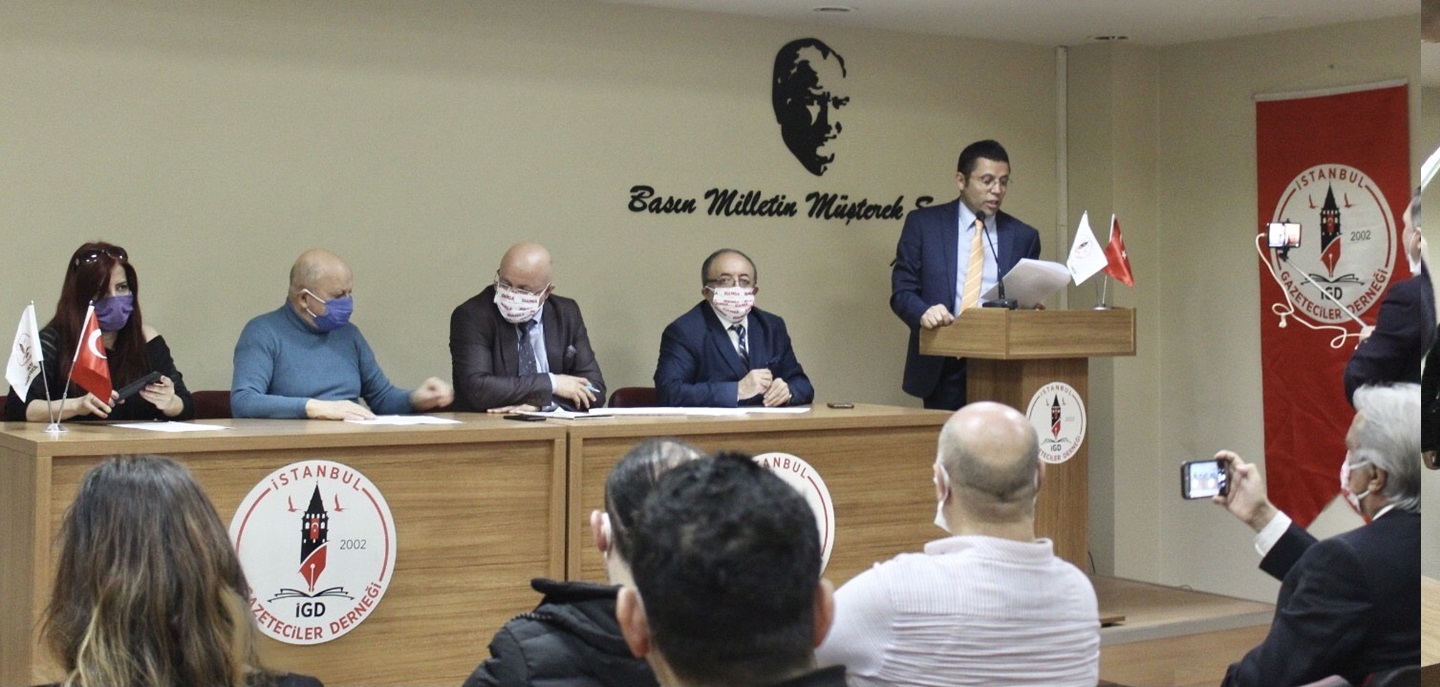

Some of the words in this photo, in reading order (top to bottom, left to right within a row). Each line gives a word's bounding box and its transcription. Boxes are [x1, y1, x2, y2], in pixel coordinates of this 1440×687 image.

[628, 185, 696, 214] Basın
[704, 188, 798, 217] Milletin
[805, 191, 904, 225] Müşterek
[1350, 230, 1372, 242] 2002
[1039, 448, 1061, 461] TECİLER
[757, 457, 806, 479] ANBUL
[340, 539, 367, 550] 2002
